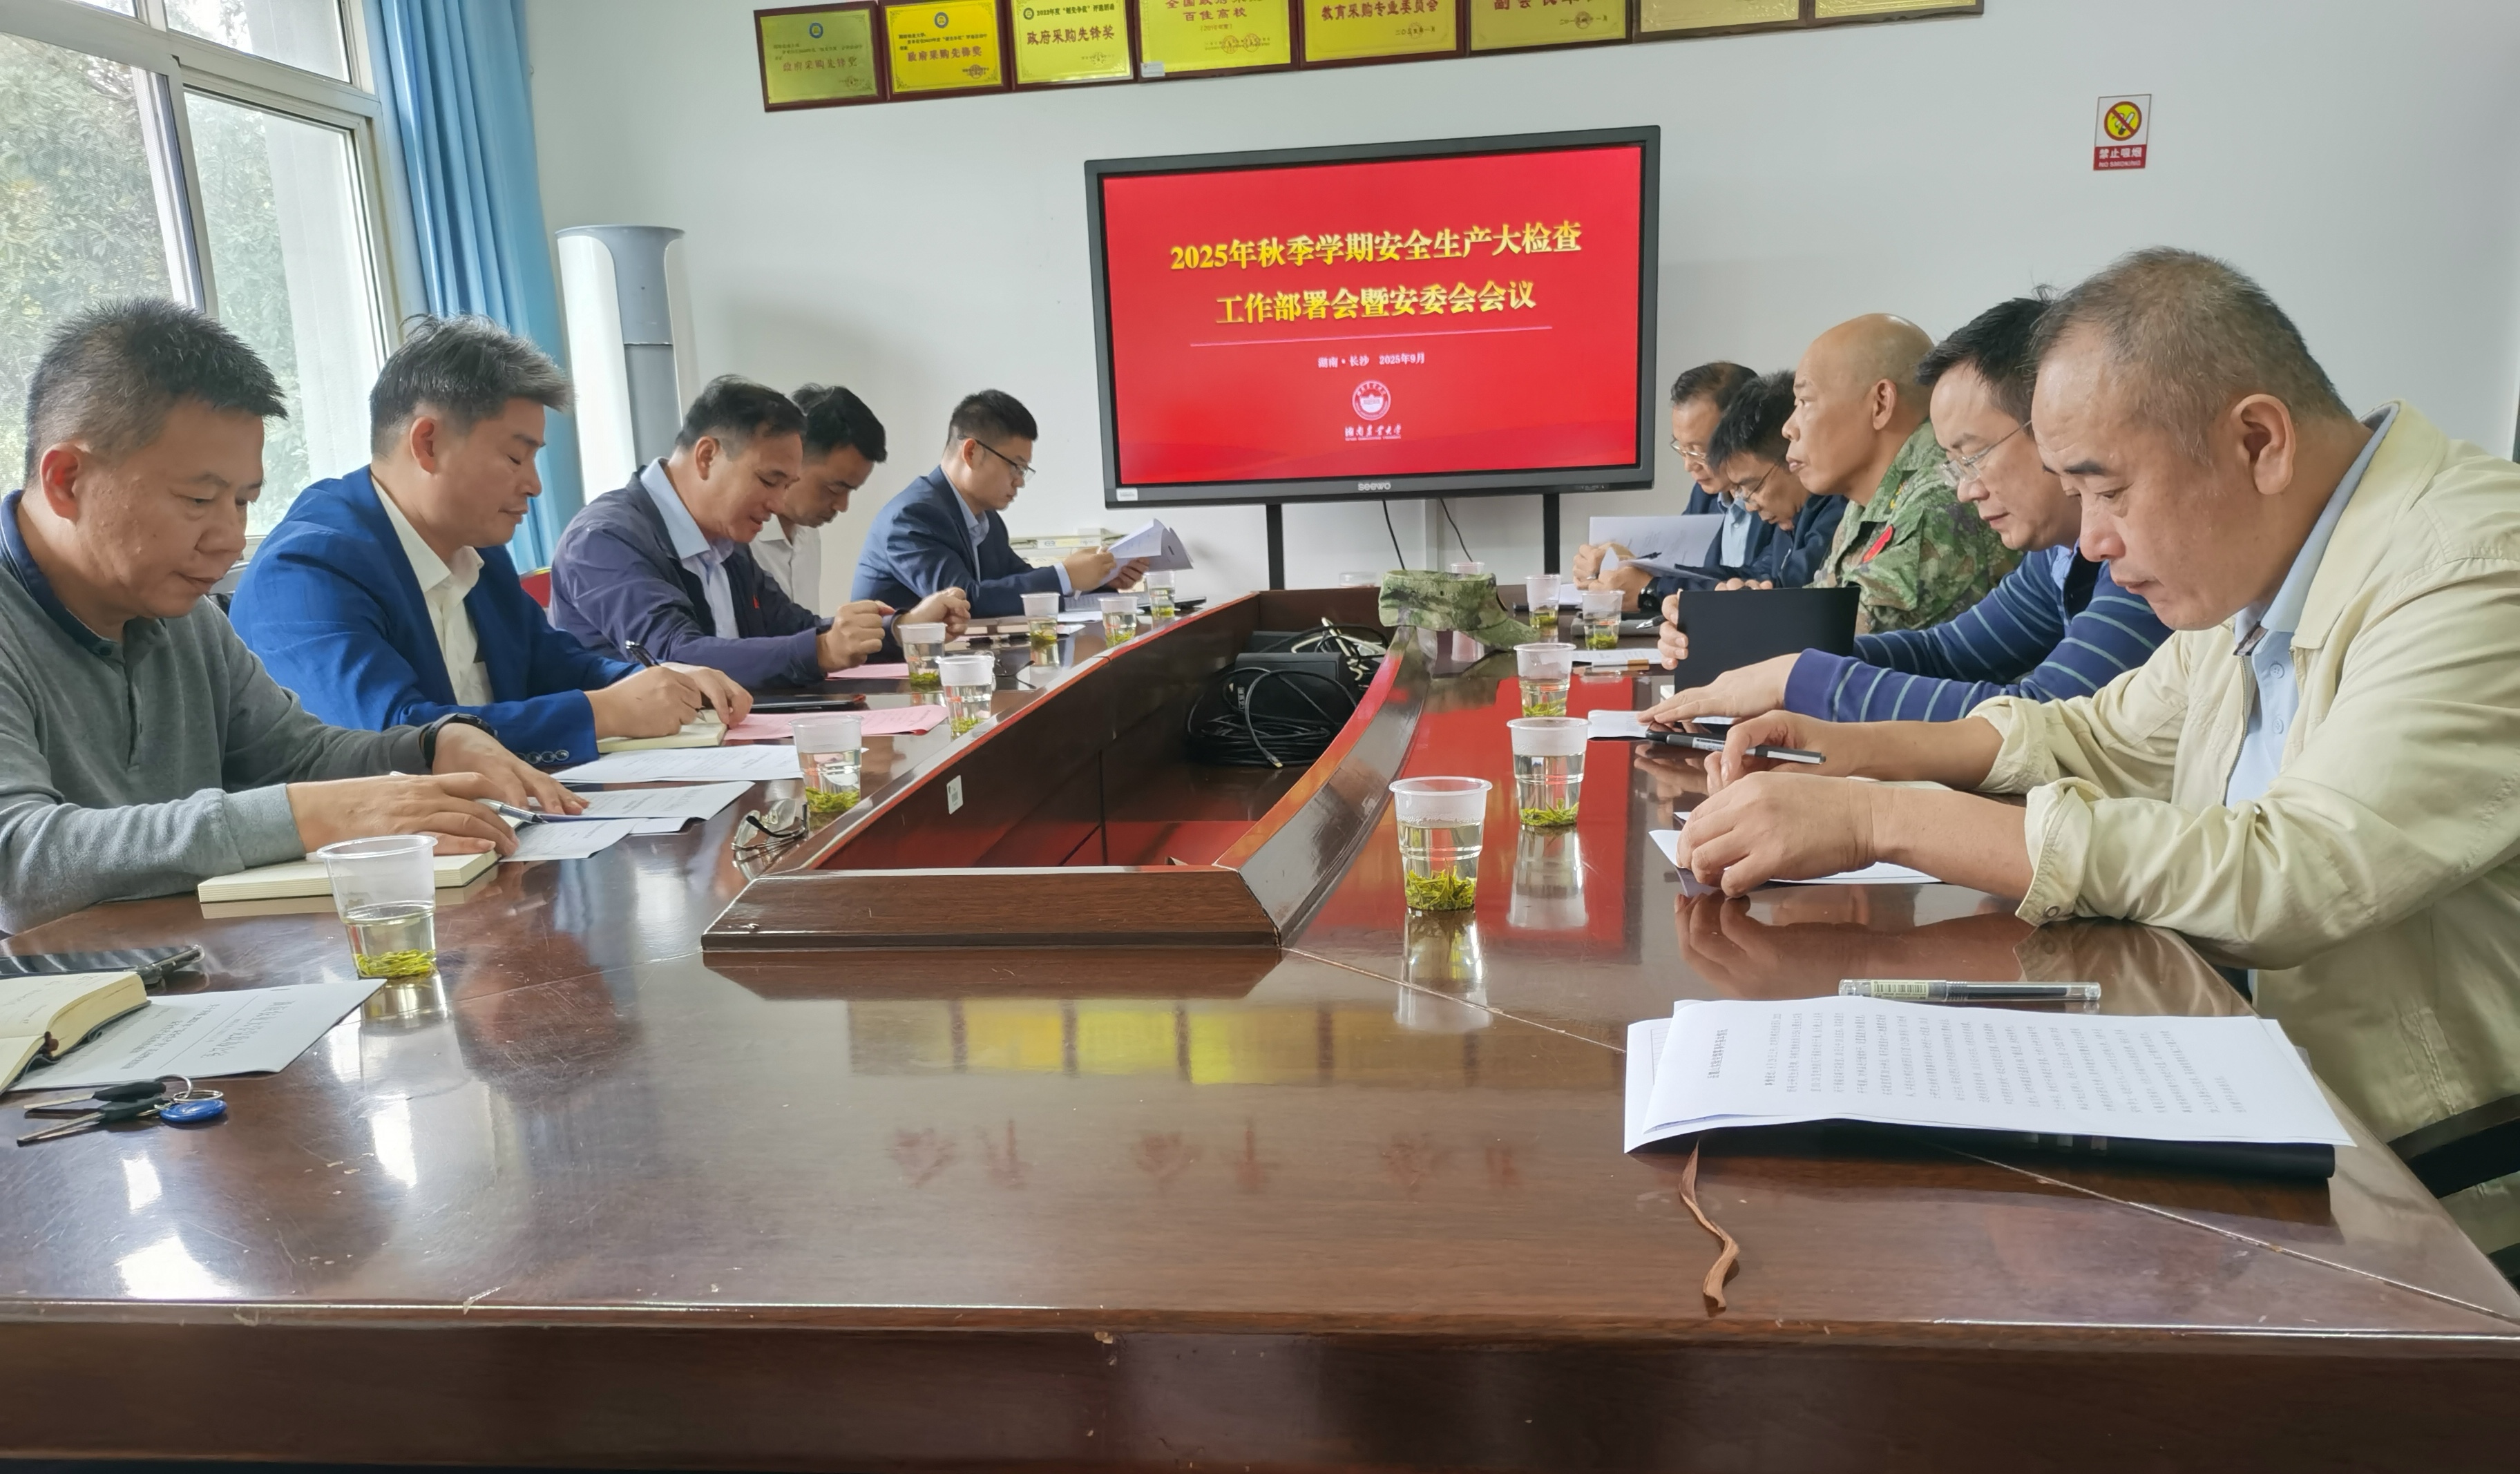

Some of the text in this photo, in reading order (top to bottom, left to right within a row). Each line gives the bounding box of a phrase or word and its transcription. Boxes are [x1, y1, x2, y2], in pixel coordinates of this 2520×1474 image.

[1183, 7, 1248, 21] 百佳高校
[1321, 0, 1439, 21] 教育采购专业委员会
[1027, 23, 1115, 46] 政府采购先锋奖
[907, 46, 982, 62] 政府采购先锋奖
[783, 56, 858, 72] 政府采购先锋奖
[1170, 220, 1583, 270] 2025年秋季学期安全生产大检查
[1215, 280, 1537, 324] 工作部署会暨安委会会议
[1379, 352, 1425, 365] 2025年9月
[1357, 482, 1391, 491] seewo
